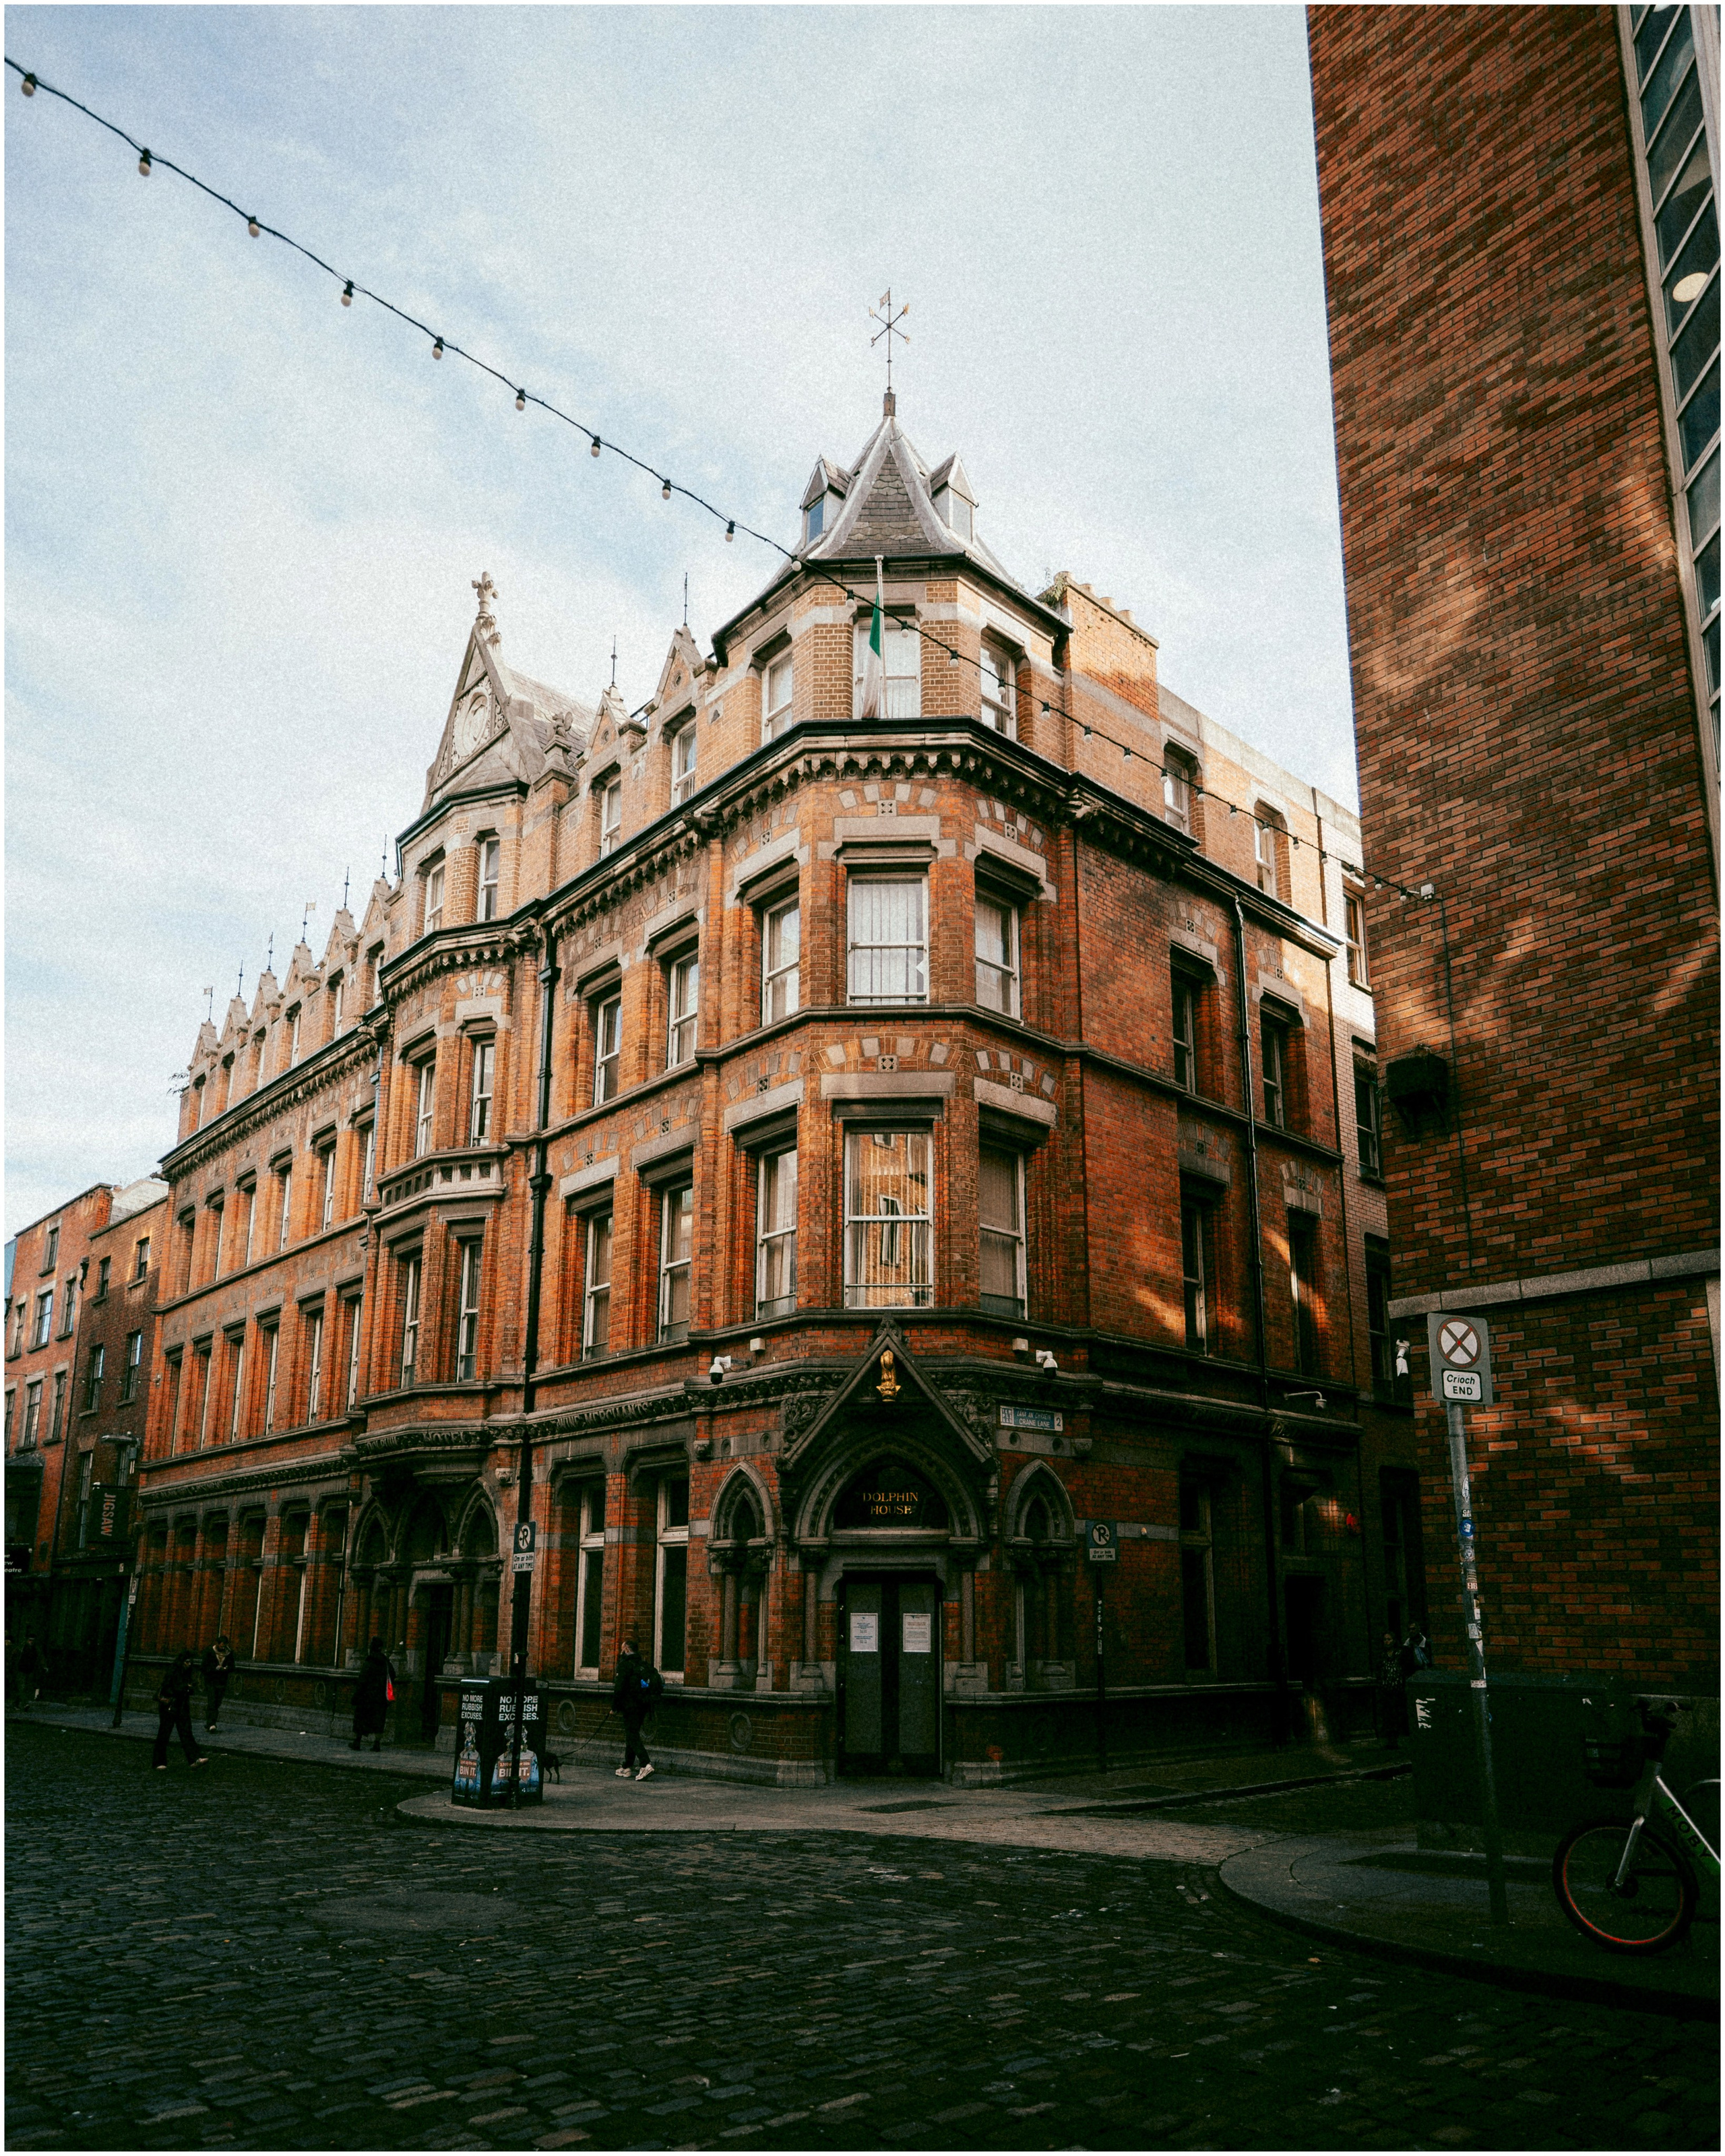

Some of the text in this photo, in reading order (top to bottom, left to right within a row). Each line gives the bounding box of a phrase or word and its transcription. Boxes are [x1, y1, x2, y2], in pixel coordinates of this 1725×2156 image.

[1453, 1386, 1473, 1395] END
[1019, 1418, 1036, 1426] CRANE
[1056, 1417, 1061, 1426] 2
[862, 1492, 918, 1502] DOLPHIN
[100, 1492, 117, 1536] JIGSAW
[871, 1505, 912, 1515] HOUSE
[462, 1694, 483, 1703] NO MORE
[514, 1695, 538, 1703] ORE
[462, 1702, 482, 1712] RUBBISH
[499, 1704, 538, 1713] RUBISH
[461, 1711, 483, 1720] EXCUSES.
[499, 1712, 539, 1721] EXCSES.
[460, 1765, 469, 1775] BIN
[519, 1767, 530, 1777] IT.
